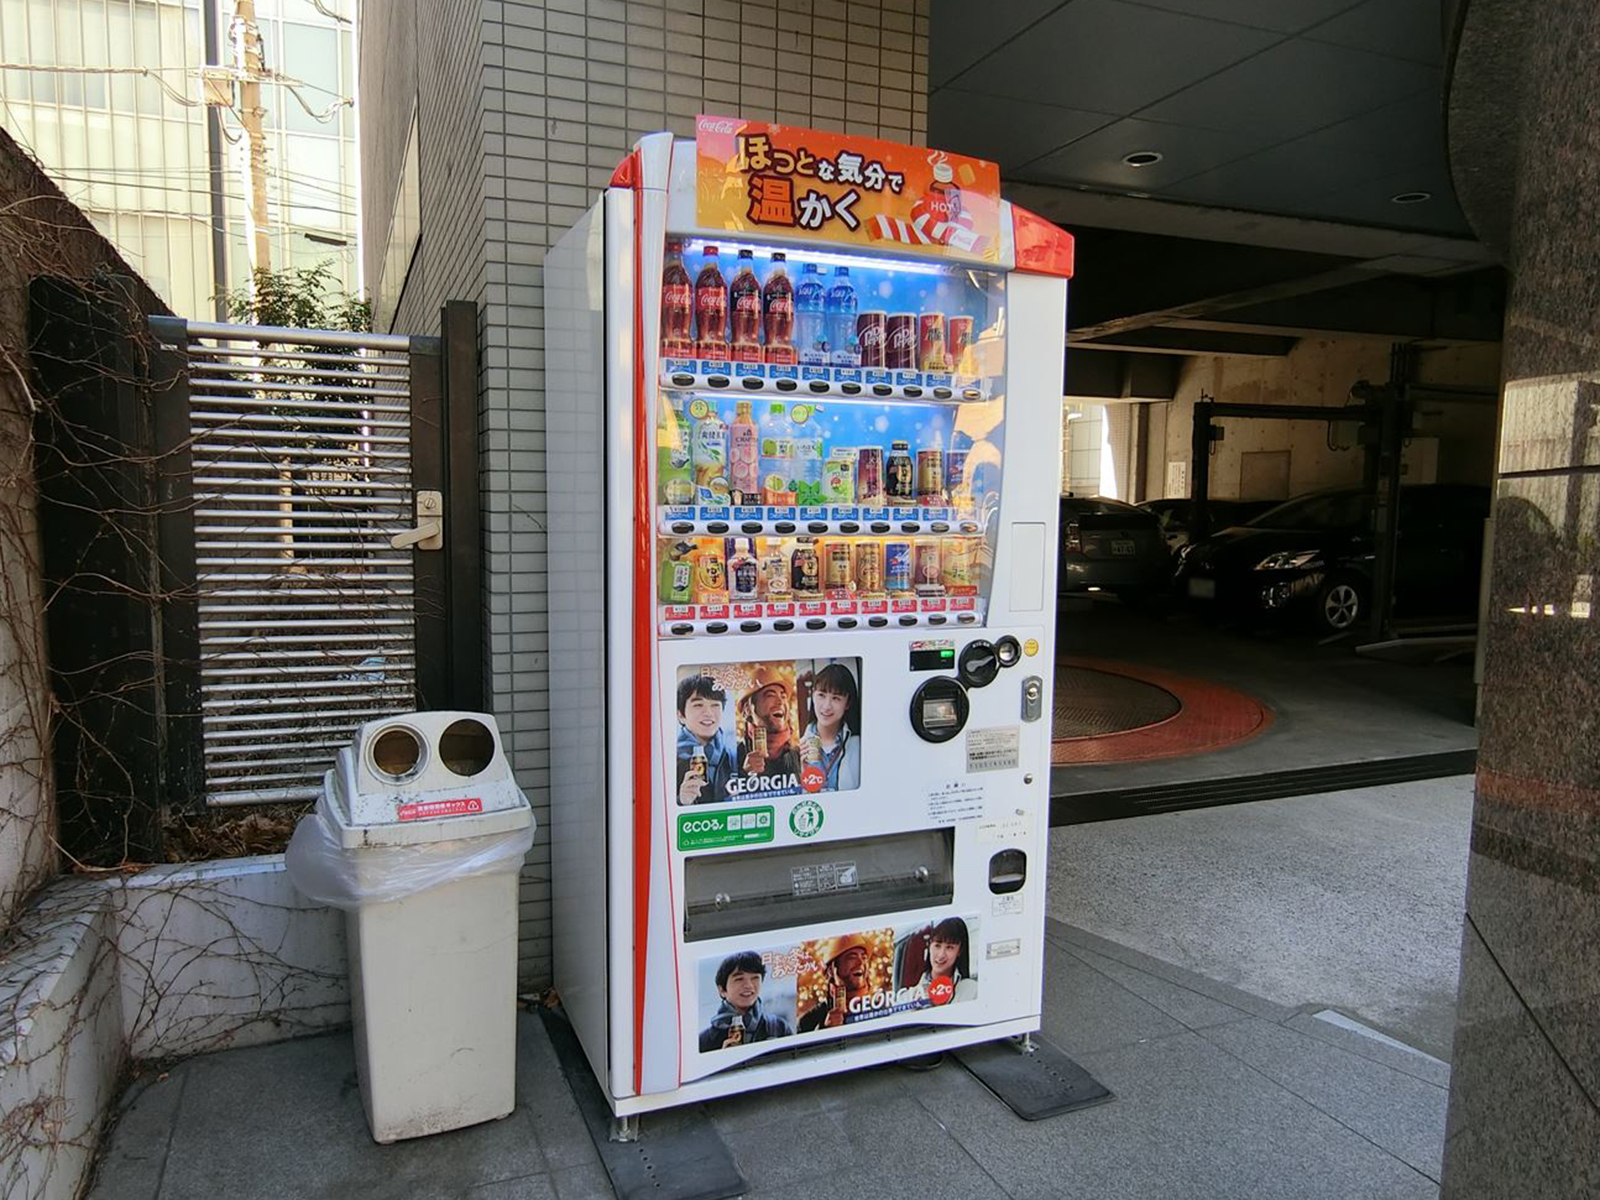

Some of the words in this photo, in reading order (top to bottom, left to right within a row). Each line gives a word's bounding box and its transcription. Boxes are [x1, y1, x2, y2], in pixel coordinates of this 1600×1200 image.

[738, 132, 905, 194] ほっとな気分で
[747, 174, 861, 232] 温かく
[725, 772, 799, 795] GEORGIA
[849, 987, 928, 1014] GEORGIA
